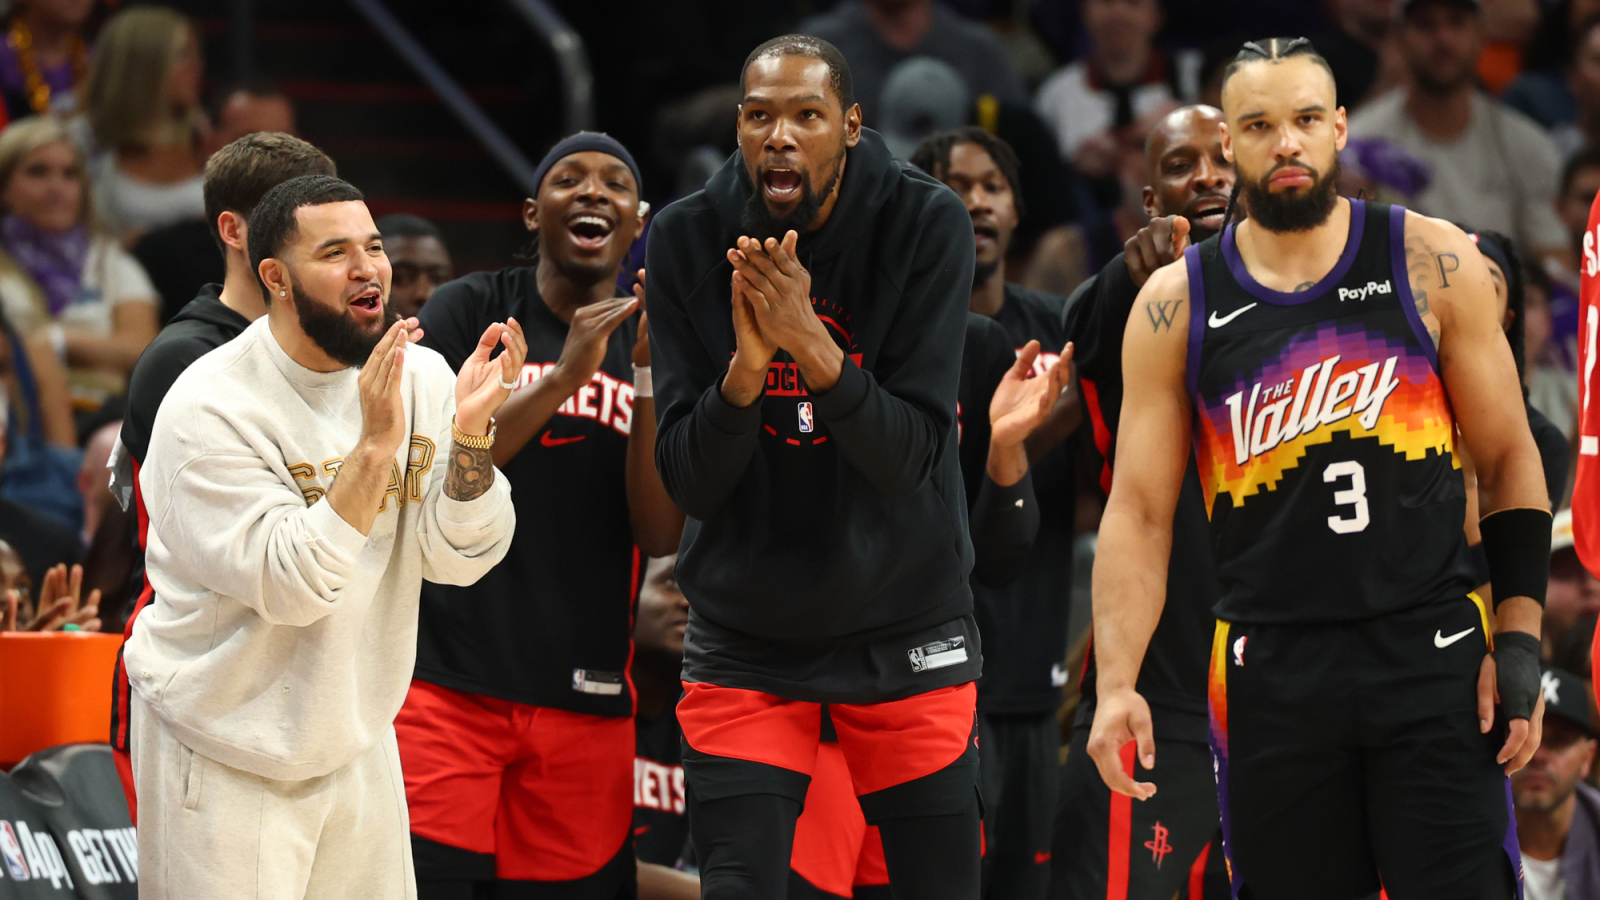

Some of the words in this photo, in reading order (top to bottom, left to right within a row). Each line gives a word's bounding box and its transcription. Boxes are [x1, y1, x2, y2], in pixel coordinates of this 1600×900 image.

[1338, 280, 1392, 302] PayPal
[1430, 250, 1460, 290] P
[1145, 299, 1184, 334] W
[1225, 355, 1400, 466] Valley
[1262, 378, 1295, 404] THE
[286, 434, 436, 514] SAR
[1322, 460, 1371, 535] 3
[633, 757, 686, 815] ETS
[67, 828, 121, 885] GET
